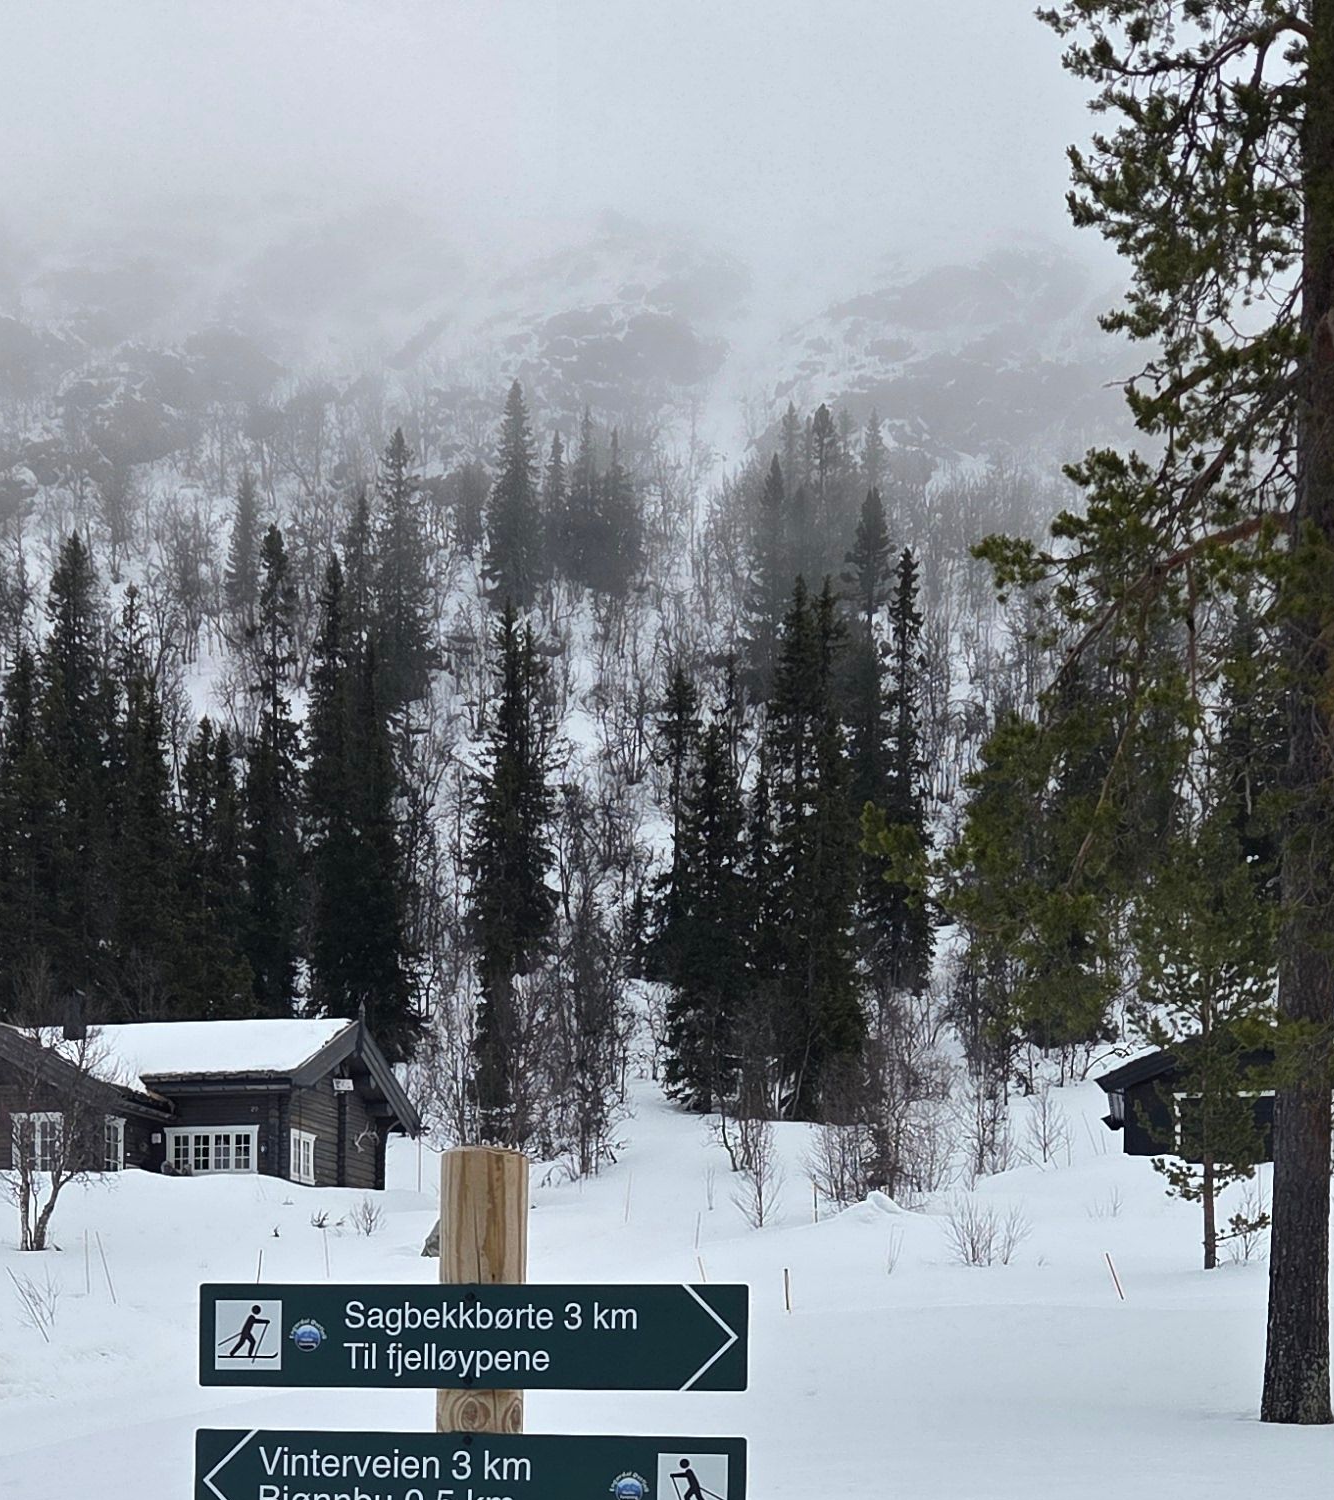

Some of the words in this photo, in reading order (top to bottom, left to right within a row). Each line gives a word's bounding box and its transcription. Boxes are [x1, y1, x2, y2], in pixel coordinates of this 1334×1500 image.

[343, 1301, 553, 1335] Sagbekkbørte
[563, 1303, 583, 1331] 3
[593, 1302, 638, 1330] km
[343, 1343, 377, 1370] Til
[385, 1343, 550, 1378] fjelløypene
[258, 1446, 440, 1480] Vinterveien
[451, 1451, 471, 1480] 3
[484, 1450, 532, 1481] km
